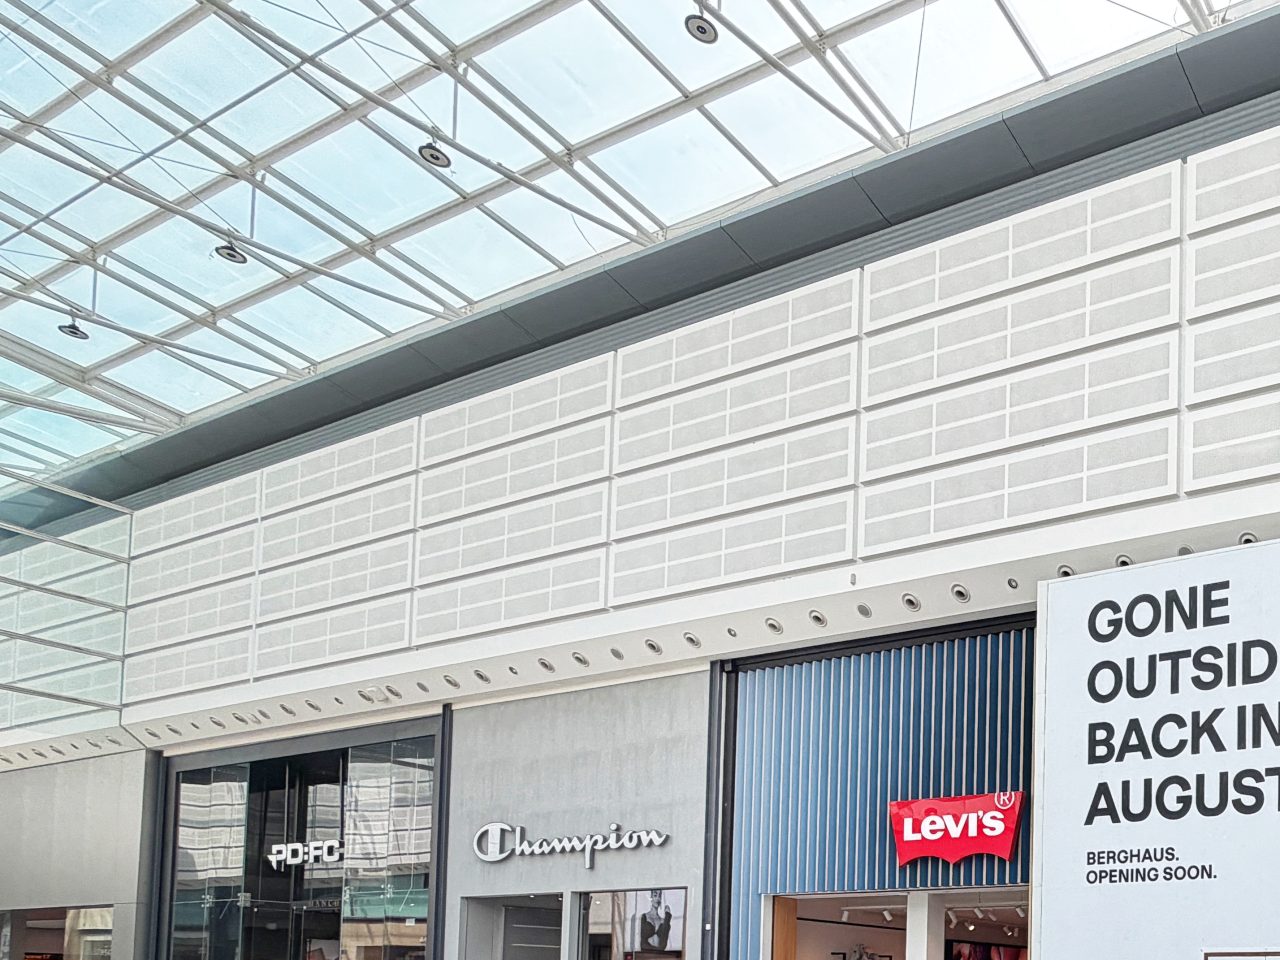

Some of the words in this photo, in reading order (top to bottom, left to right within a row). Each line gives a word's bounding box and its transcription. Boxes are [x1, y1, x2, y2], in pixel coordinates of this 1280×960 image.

[1087, 580, 1230, 643] GONE
[1087, 707, 1227, 765] BACK
[473, 822, 668, 869] Champion
[1086, 847, 1180, 866] BERGHAUS.
[1086, 867, 1159, 885] OPENING
[1162, 864, 1218, 881] SOON.
